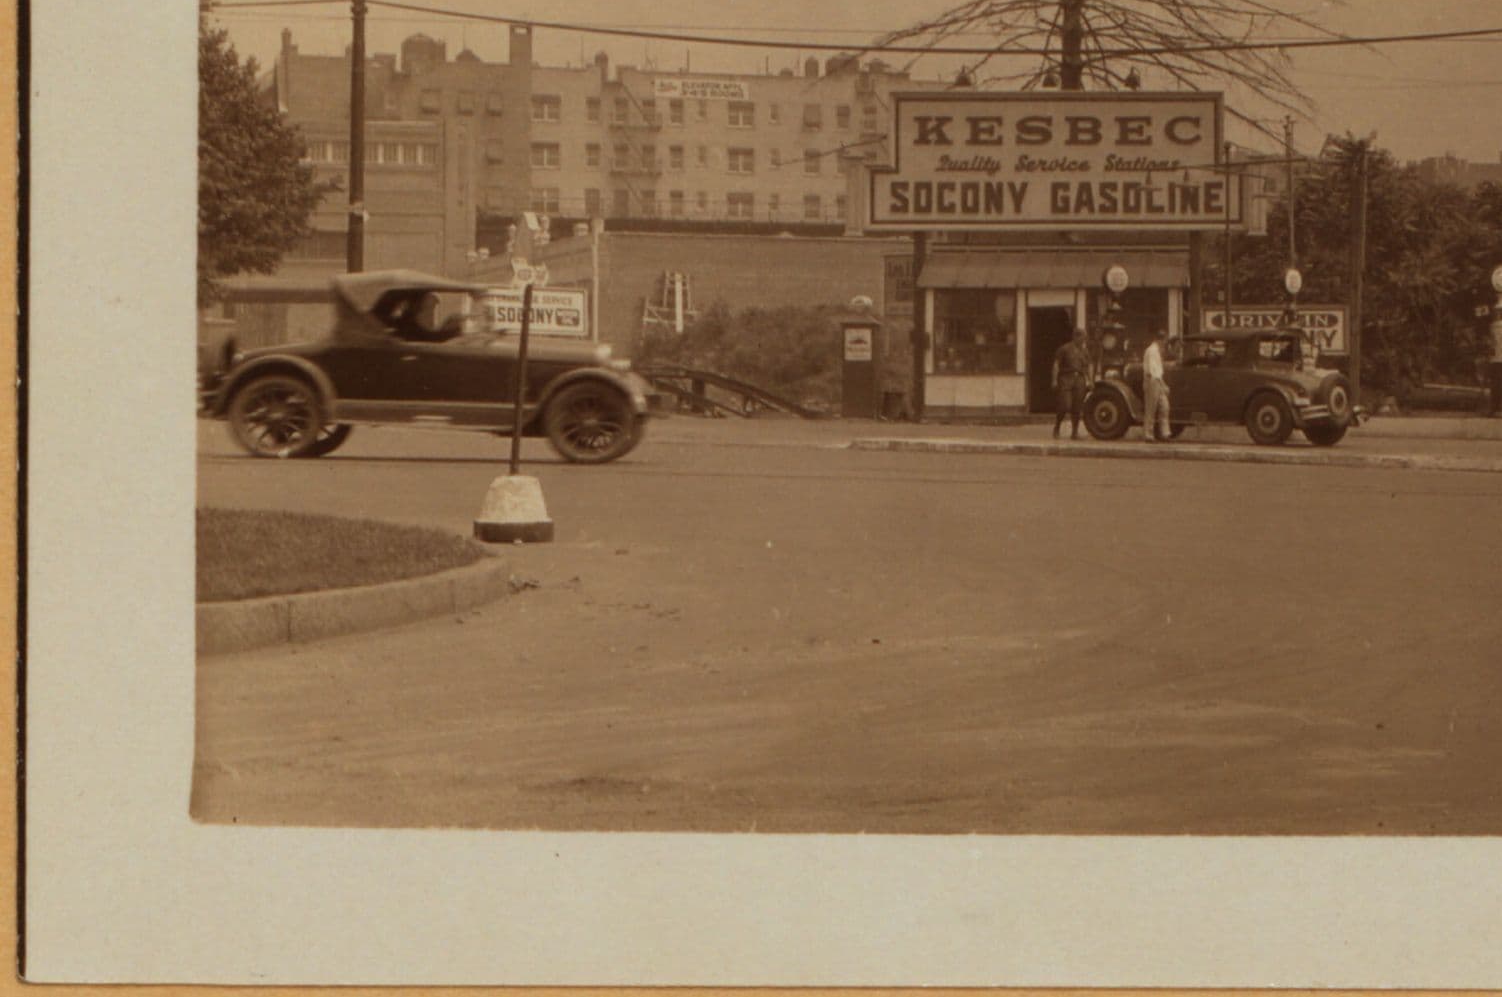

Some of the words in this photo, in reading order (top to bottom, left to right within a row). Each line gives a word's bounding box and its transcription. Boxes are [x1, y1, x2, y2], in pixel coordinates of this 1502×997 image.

[912, 115, 1203, 146] KESBEC
[934, 154, 1001, 176] Quality
[1014, 153, 1091, 172] Service
[1103, 153, 1181, 172] Stations
[889, 180, 1029, 214] SOCONY
[1049, 180, 1224, 214] GASOLINE
[1221, 314, 1294, 327] DRIV
